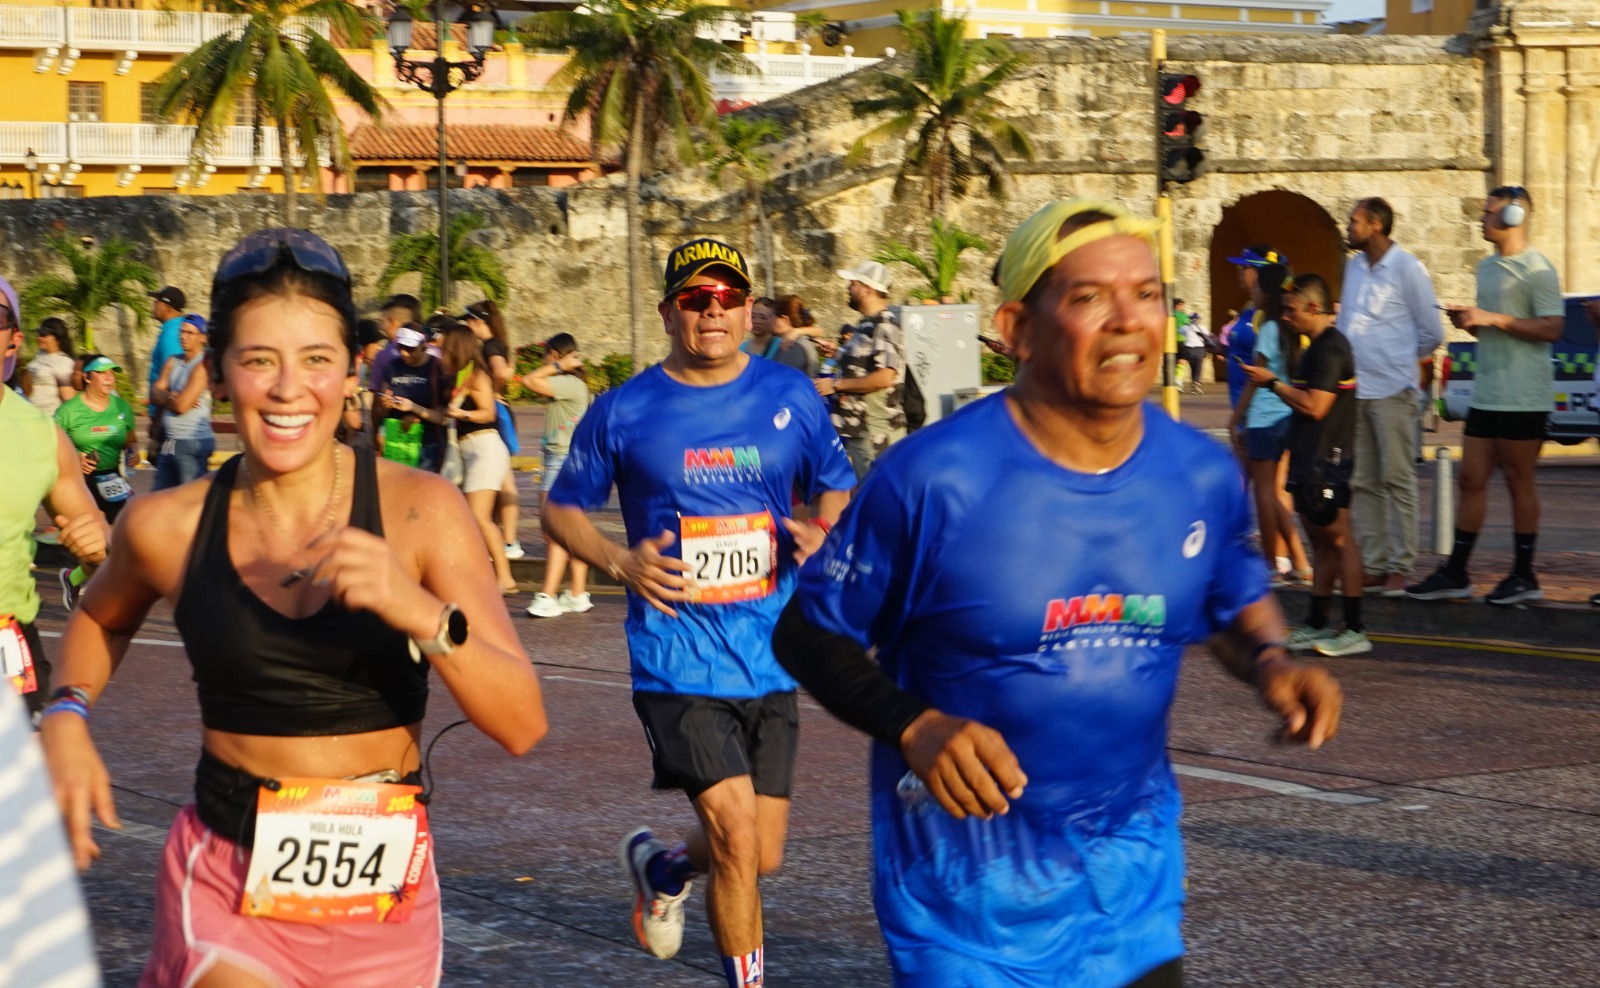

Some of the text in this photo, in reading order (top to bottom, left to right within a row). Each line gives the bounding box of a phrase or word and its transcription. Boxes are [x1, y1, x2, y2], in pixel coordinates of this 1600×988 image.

[674, 242, 742, 271] ARMADA
[685, 446, 761, 469] MMM
[695, 547, 759, 580] 2705
[1043, 594, 1165, 631] MMM
[309, 822, 363, 836] HOLA HOLA
[272, 837, 386, 888] 2554
[406, 840, 428, 885] CORRAL
